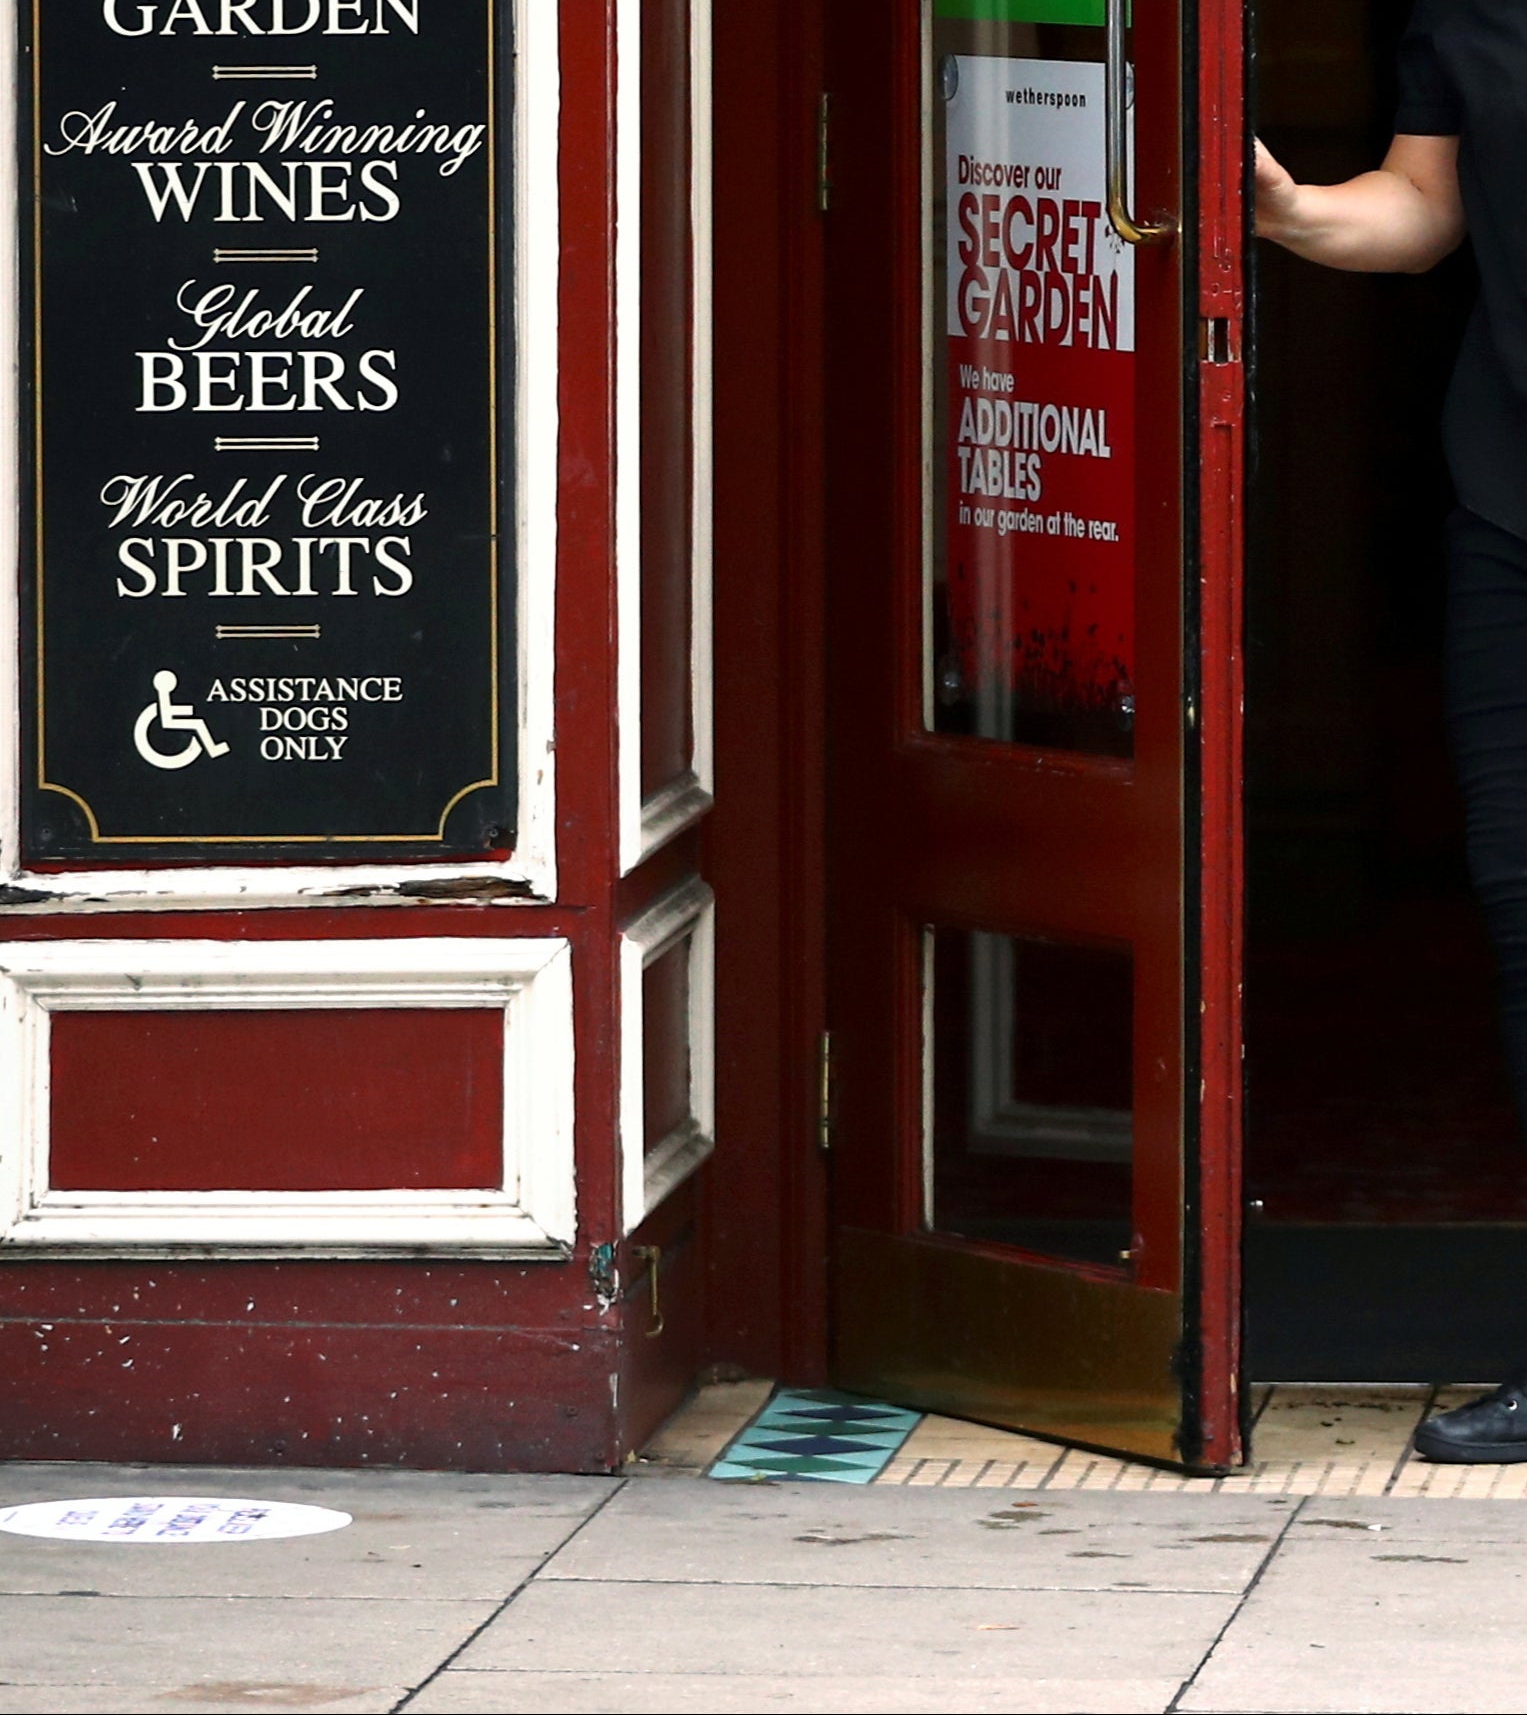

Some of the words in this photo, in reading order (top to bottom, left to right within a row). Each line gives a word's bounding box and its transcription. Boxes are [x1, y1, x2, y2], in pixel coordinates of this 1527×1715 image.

[1006, 87, 1086, 109] wetherspoon
[43, 100, 247, 157] Award
[251, 99, 486, 177] Winning
[131, 159, 401, 223] WINES
[958, 154, 1031, 189] Discover
[1034, 164, 1062, 191] our
[958, 191, 1101, 275] SECRET
[167, 279, 364, 351] Global
[957, 268, 1119, 351] GARDEN
[134, 349, 399, 412] BEERS
[960, 364, 980, 391] We
[982, 366, 1014, 394] have
[958, 397, 1111, 459] ADDITIONAL
[100, 473, 286, 529] World
[296, 473, 428, 529] Class
[958, 446, 1041, 503] TABLES
[960, 501, 970, 525] in
[974, 508, 995, 530] our
[998, 507, 1044, 538] garden
[1048, 513, 1062, 537] at
[1064, 512, 1086, 539] the
[1088, 518, 1120, 543] rear.
[116, 536, 413, 598] SPIRITS
[206, 677, 403, 702] ASSISTANCE
[259, 706, 348, 732] DOGS
[260, 735, 348, 761] ONLY
